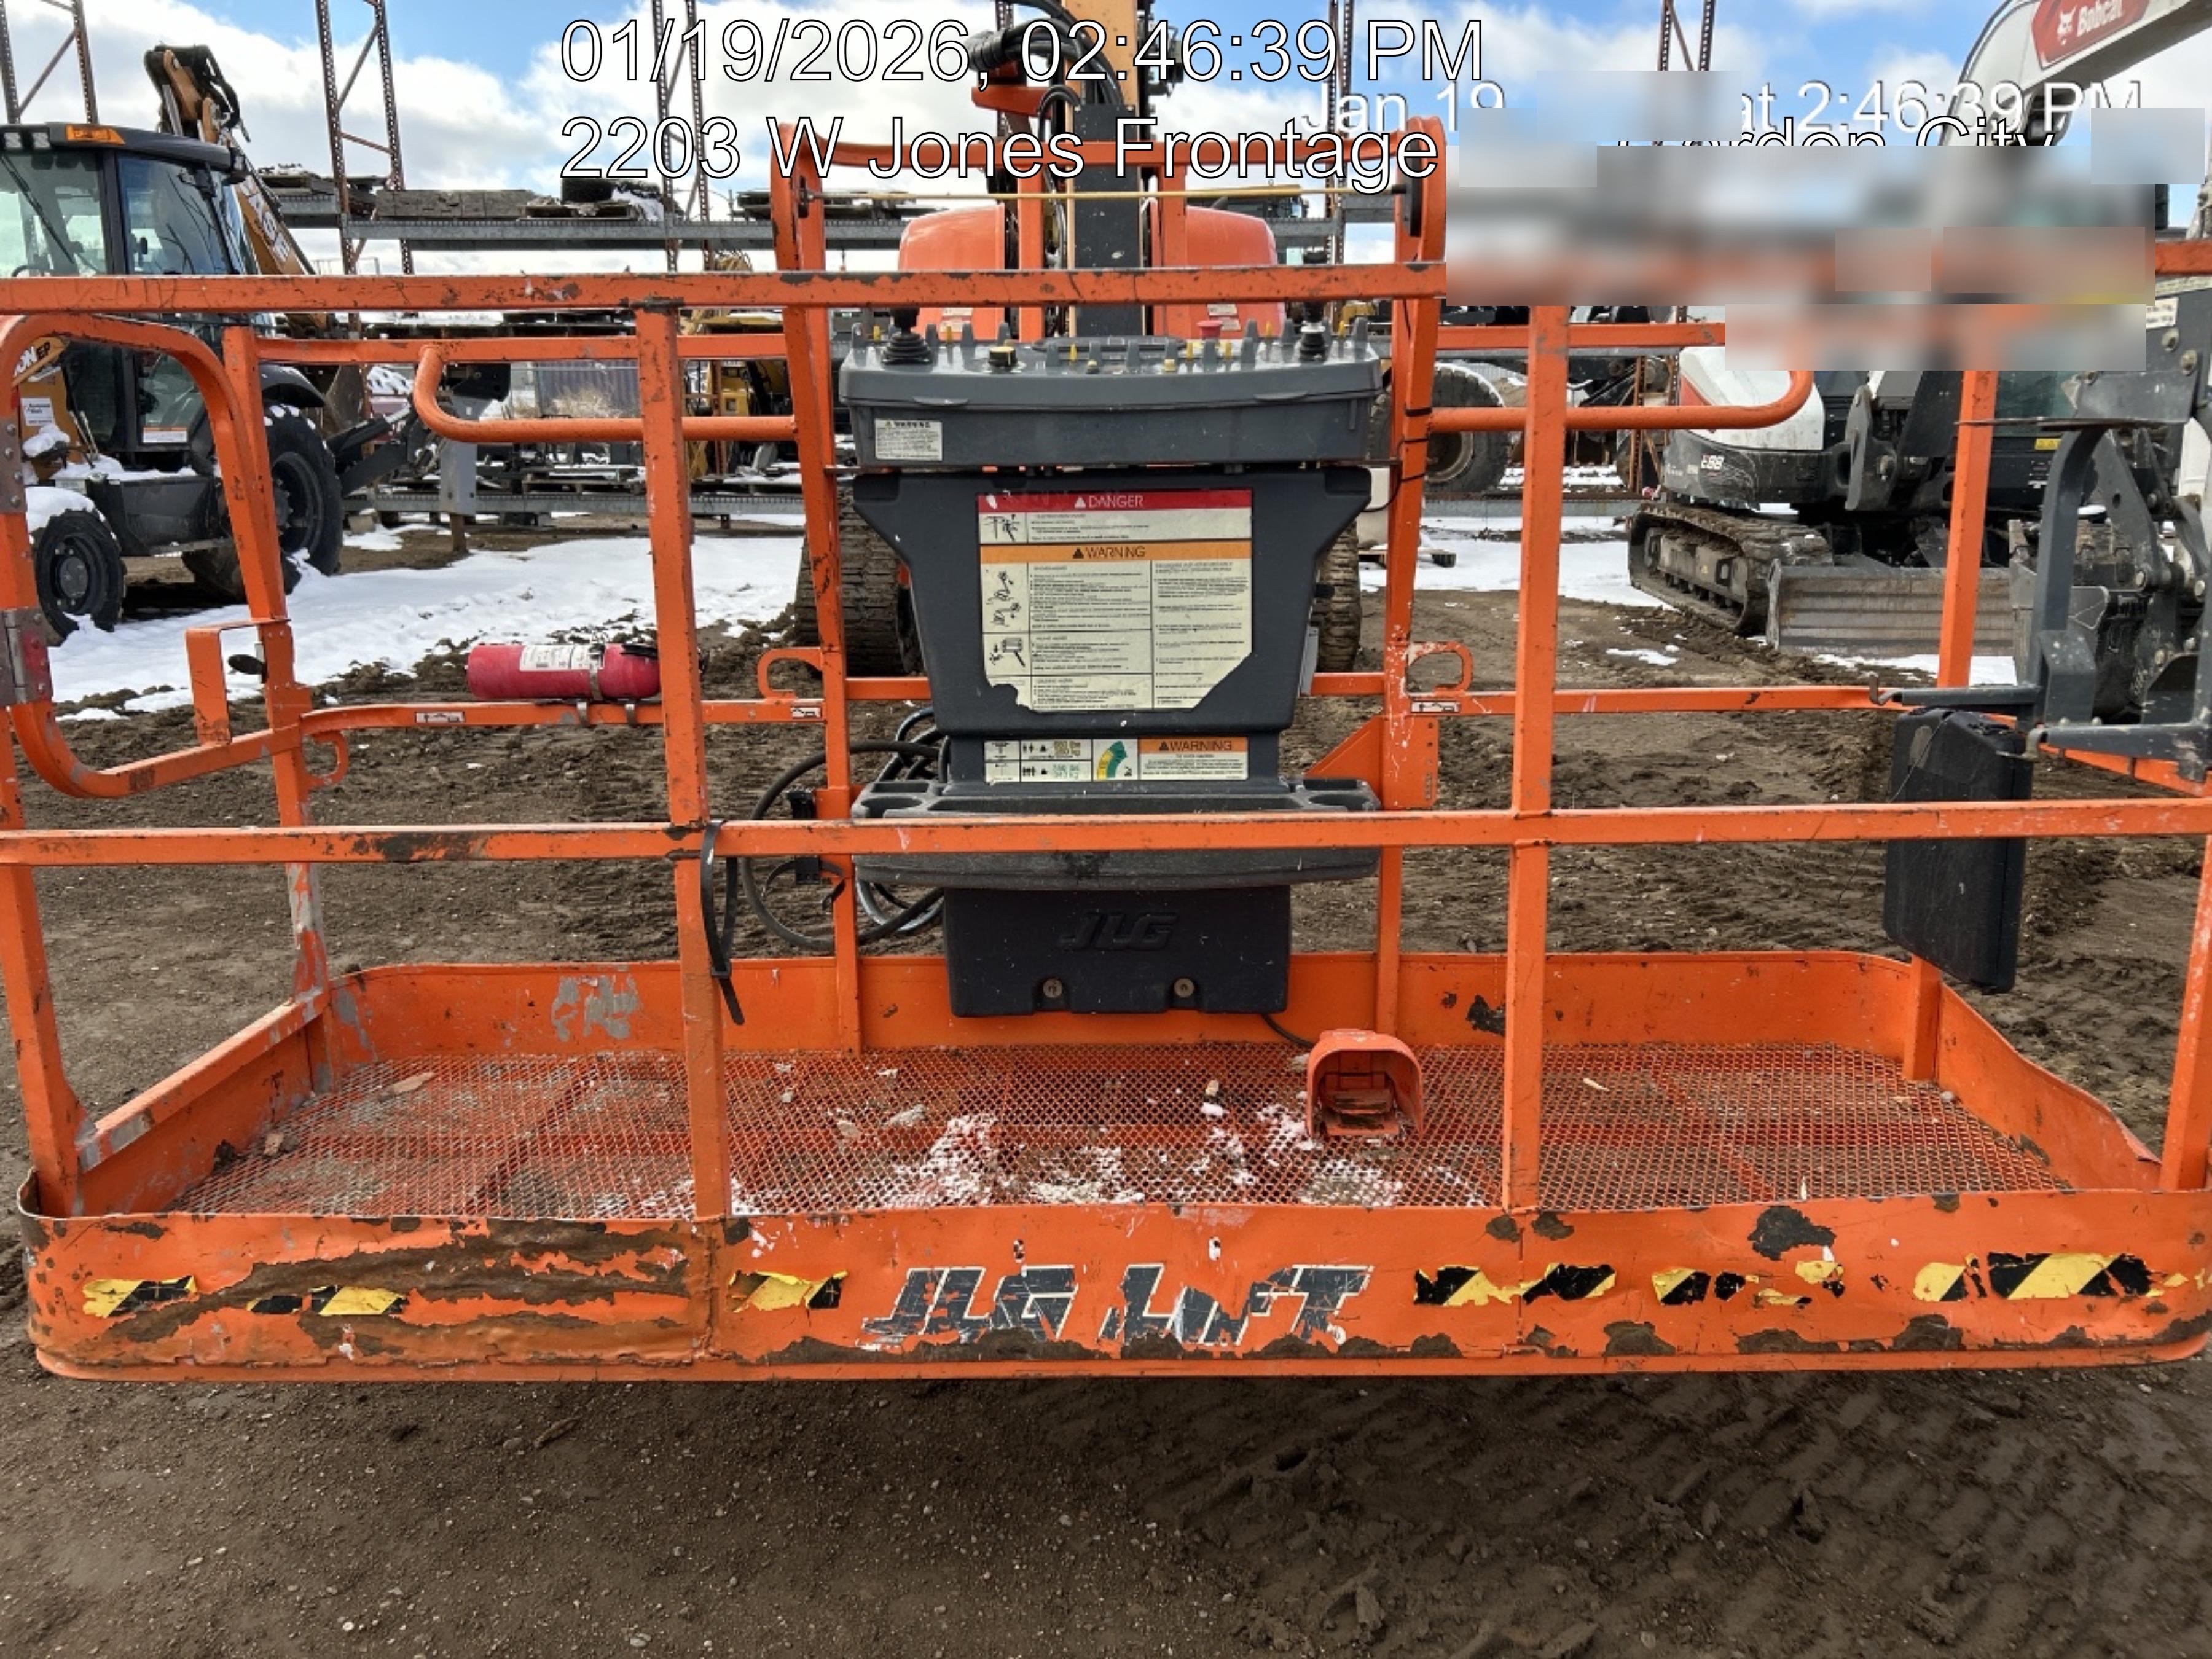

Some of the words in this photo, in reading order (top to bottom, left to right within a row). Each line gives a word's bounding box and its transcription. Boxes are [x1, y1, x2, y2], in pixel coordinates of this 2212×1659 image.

[1088, 495, 1144, 508] DANGER
[1085, 545, 1146, 559] WARNING
[1169, 740, 1233, 751] WARNING
[1057, 910, 1179, 953] JLG
